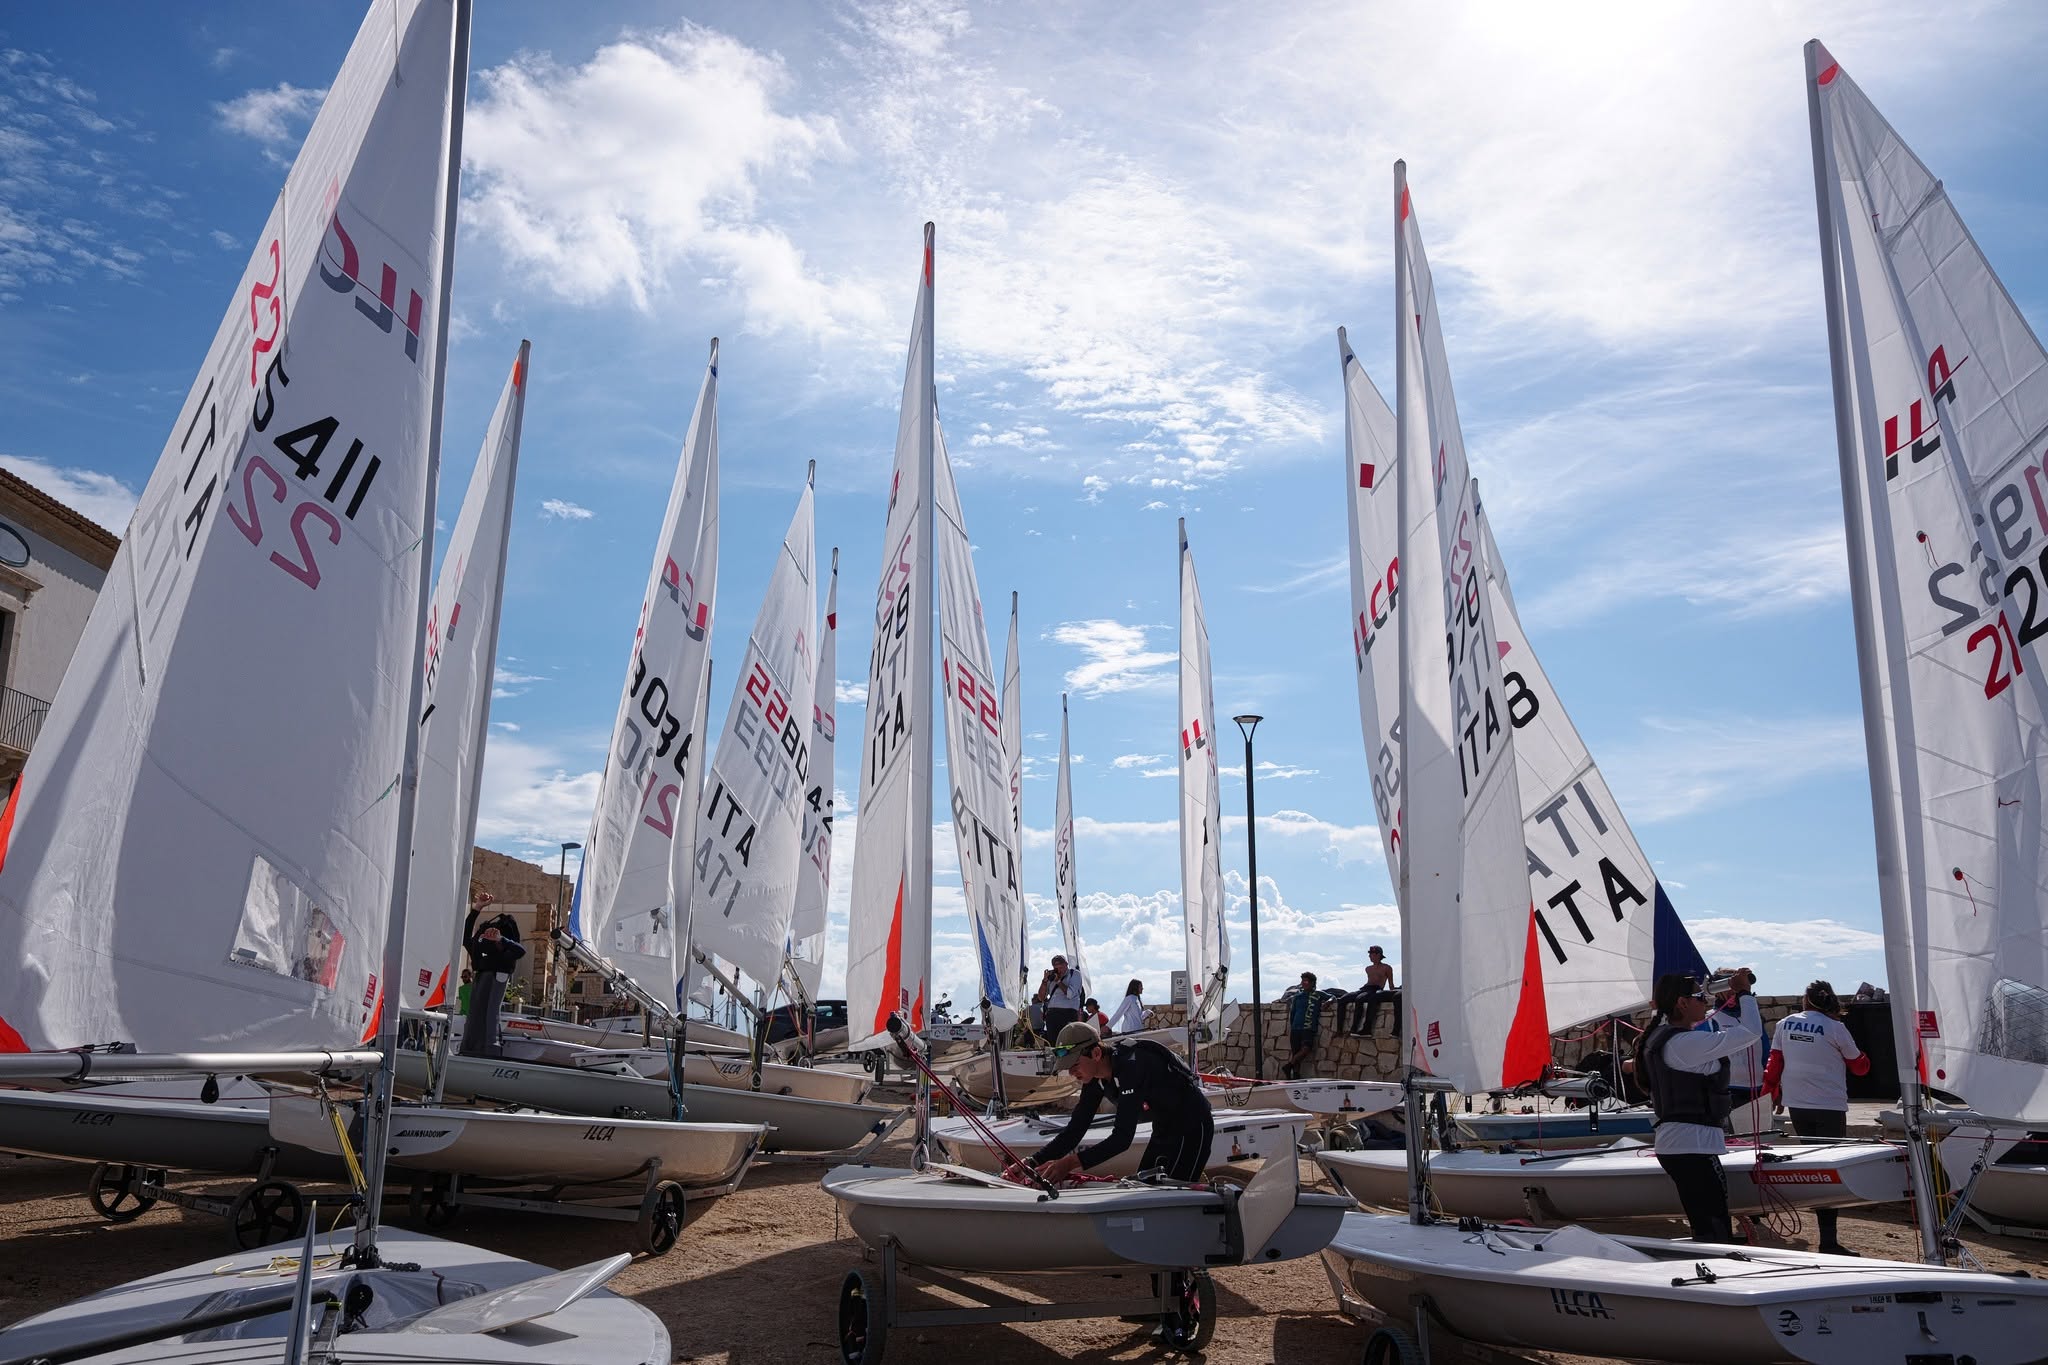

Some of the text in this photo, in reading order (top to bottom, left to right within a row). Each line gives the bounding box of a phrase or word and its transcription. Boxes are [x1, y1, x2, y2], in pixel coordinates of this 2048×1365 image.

[871, 690, 905, 788] ITA
[1458, 686, 1500, 798] ITA
[707, 782, 756, 869] ITA
[973, 817, 1019, 901] ITA
[1534, 856, 1648, 965] ITA
[1783, 1021, 1825, 1036] ITALIA
[492, 1068, 520, 1080] ILCA
[720, 1063, 742, 1075] ILCA
[72, 1111, 115, 1126] ILCA
[583, 1125, 616, 1141] ILCA
[1768, 1172, 1833, 1184] nautivela
[1550, 1287, 1614, 1320] ILCA
